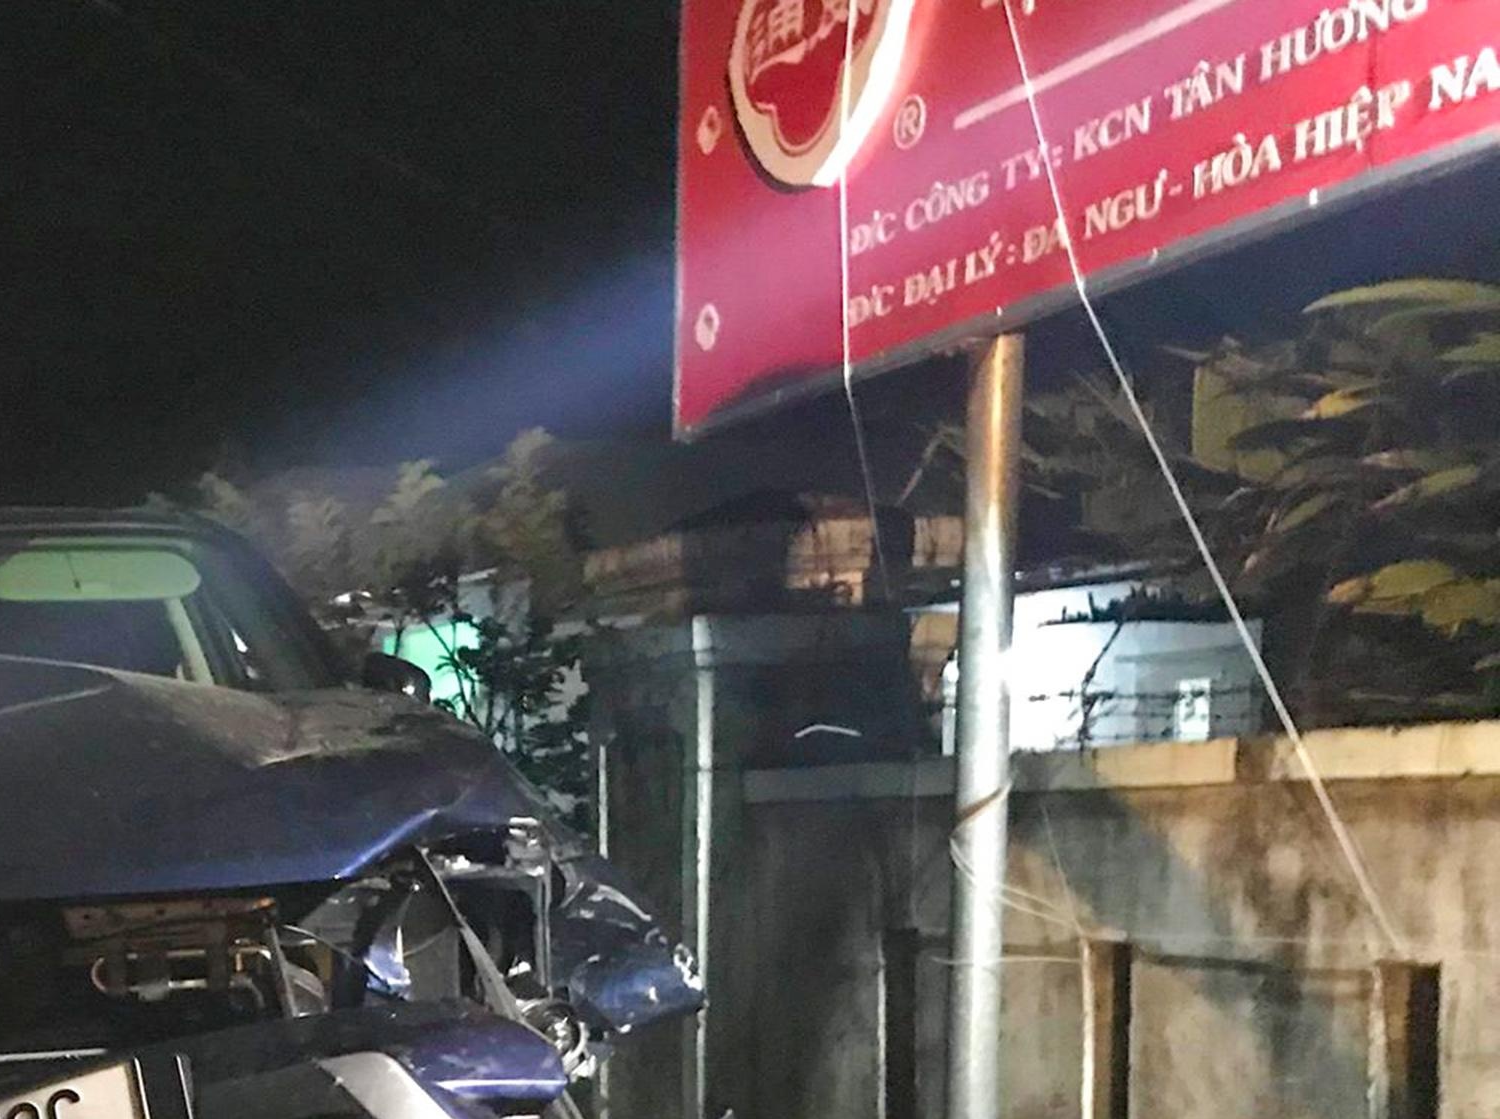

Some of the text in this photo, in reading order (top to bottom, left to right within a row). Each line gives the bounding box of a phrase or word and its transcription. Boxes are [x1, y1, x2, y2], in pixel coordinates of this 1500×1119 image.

[903, 258, 957, 307] ĐẠI
[1193, 132, 1282, 199] HÒA
[1293, 80, 1411, 162] HIỆP
[904, 170, 990, 232] CÔNG
[1073, 95, 1153, 161] KCN
[1164, 53, 1246, 120] TÂN
